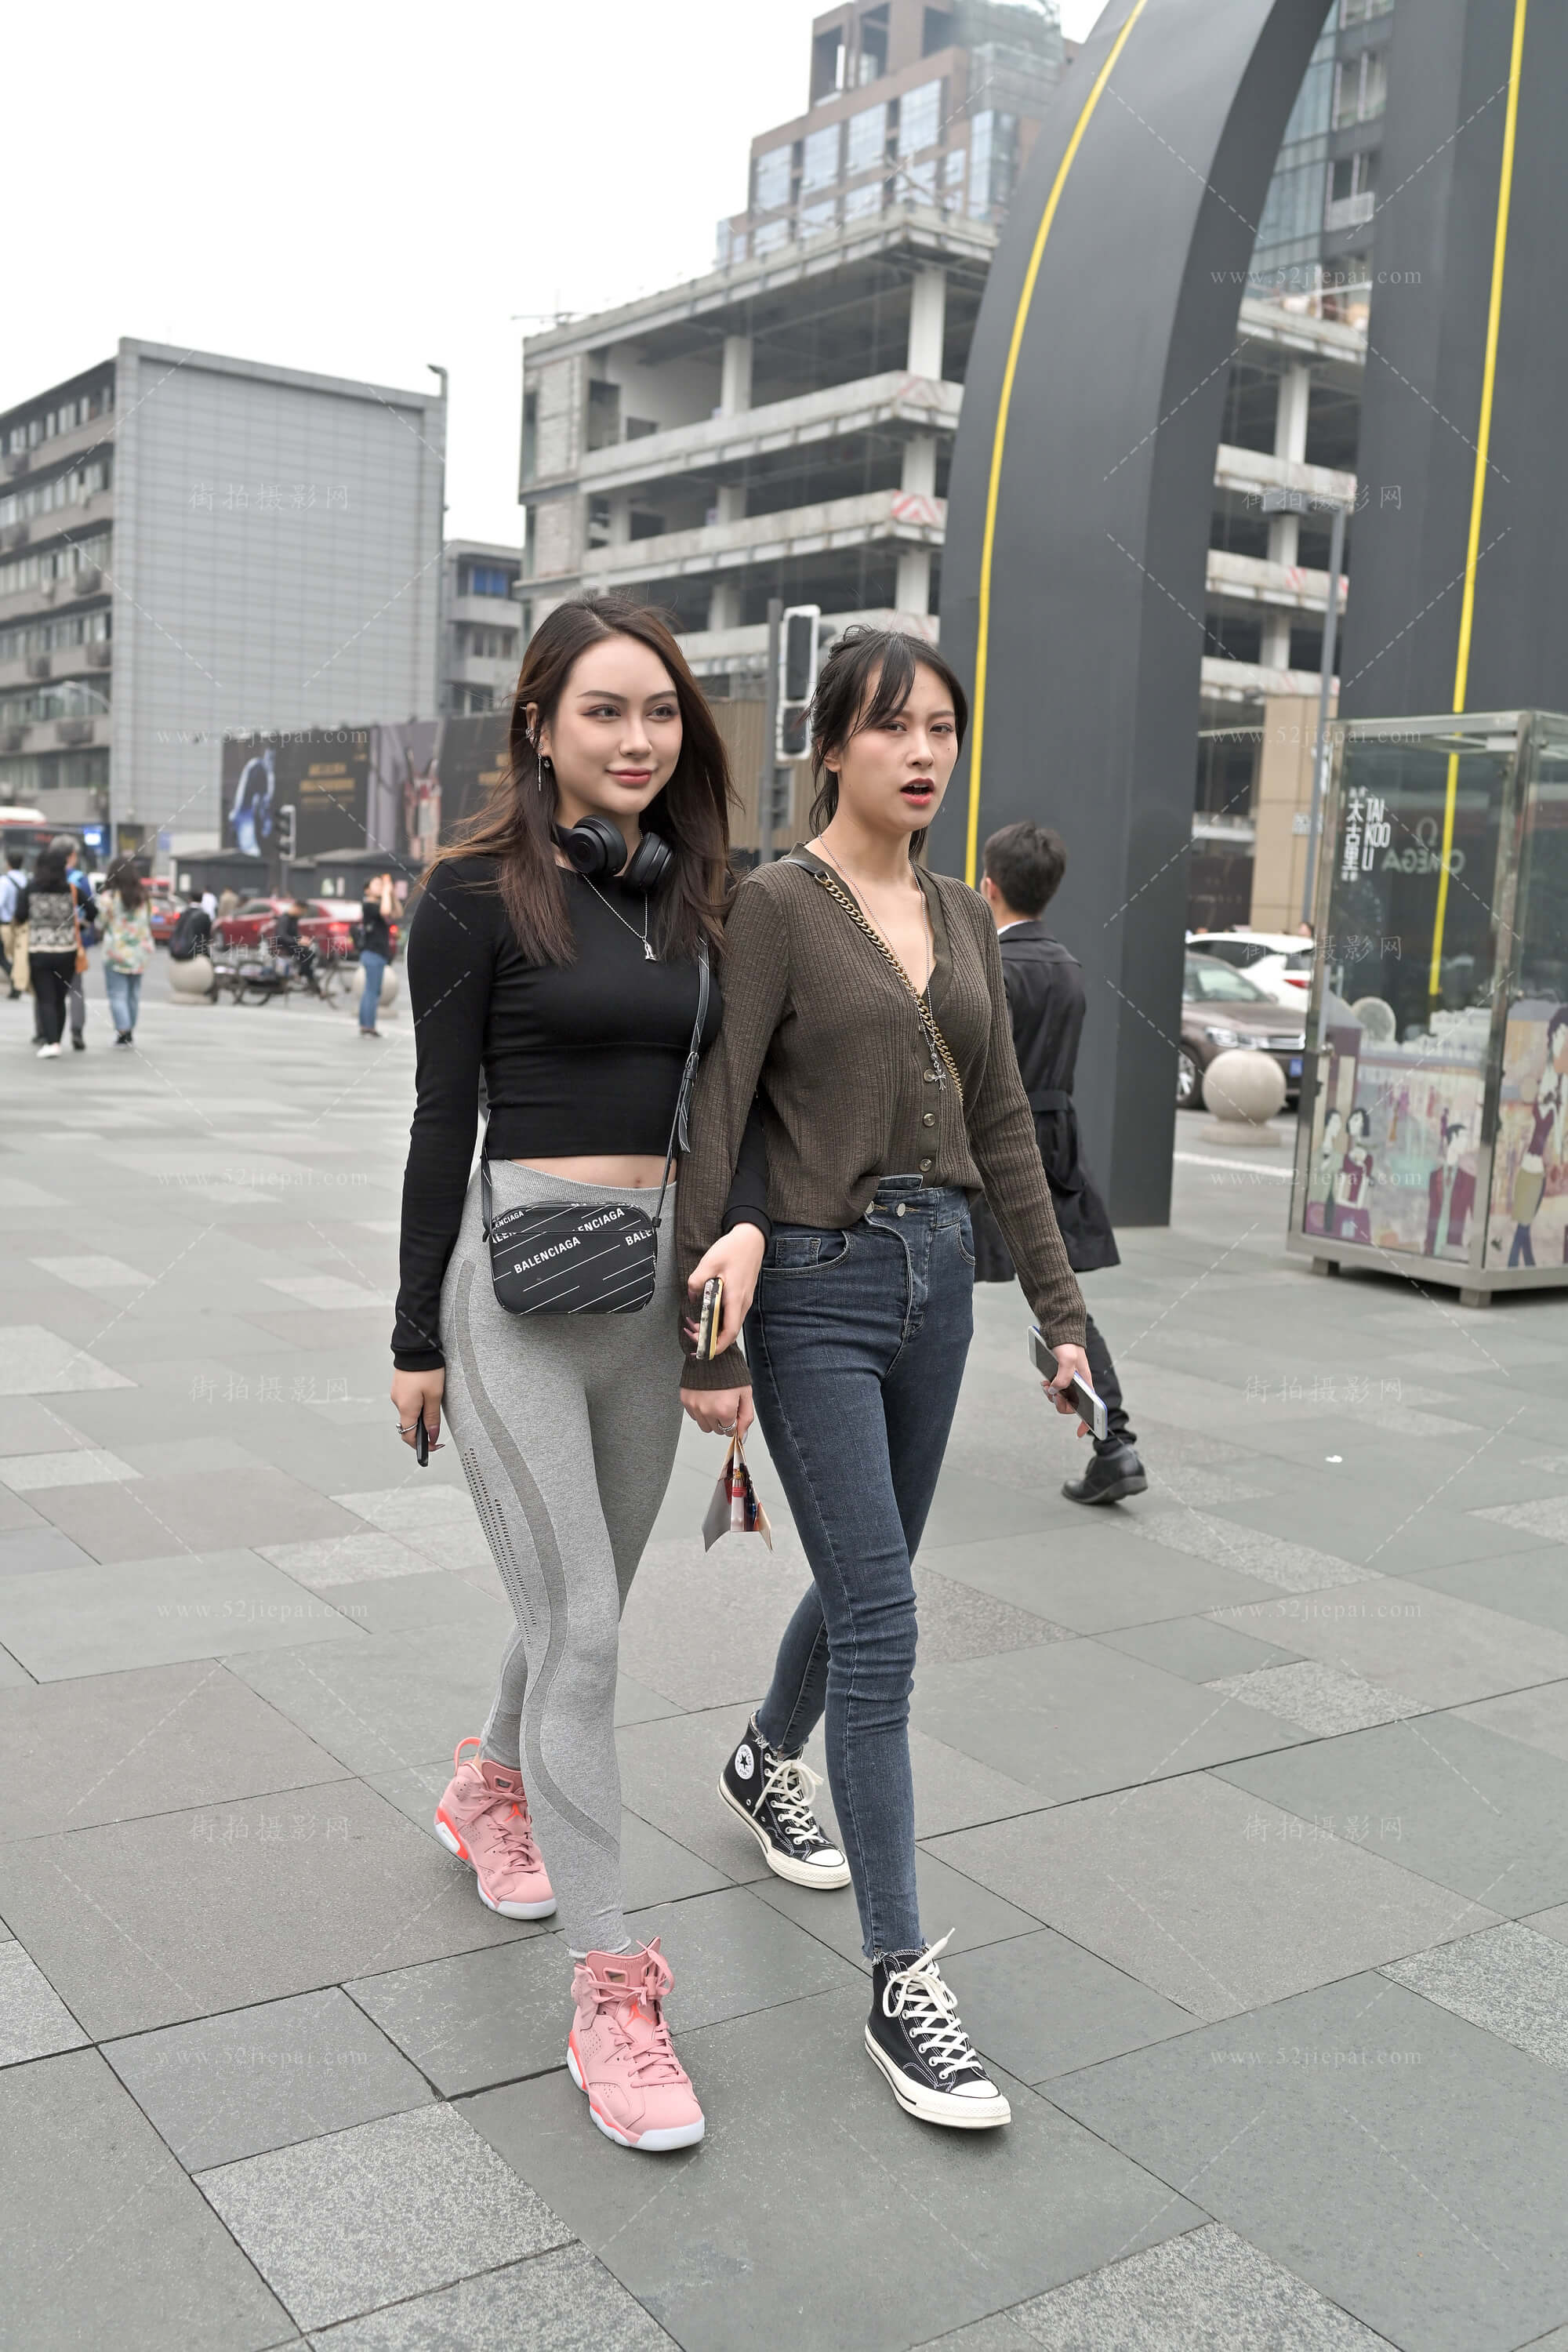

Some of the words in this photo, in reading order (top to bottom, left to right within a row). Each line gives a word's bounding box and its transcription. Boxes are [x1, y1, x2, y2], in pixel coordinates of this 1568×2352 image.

[1364, 822, 1392, 848] KOO
[494, 1210, 524, 1229] ENCIAGA
[575, 1208, 625, 1231] ENCIAGA
[625, 1229, 655, 1246] BALE
[514, 1236, 581, 1274] BALENCIAGA
